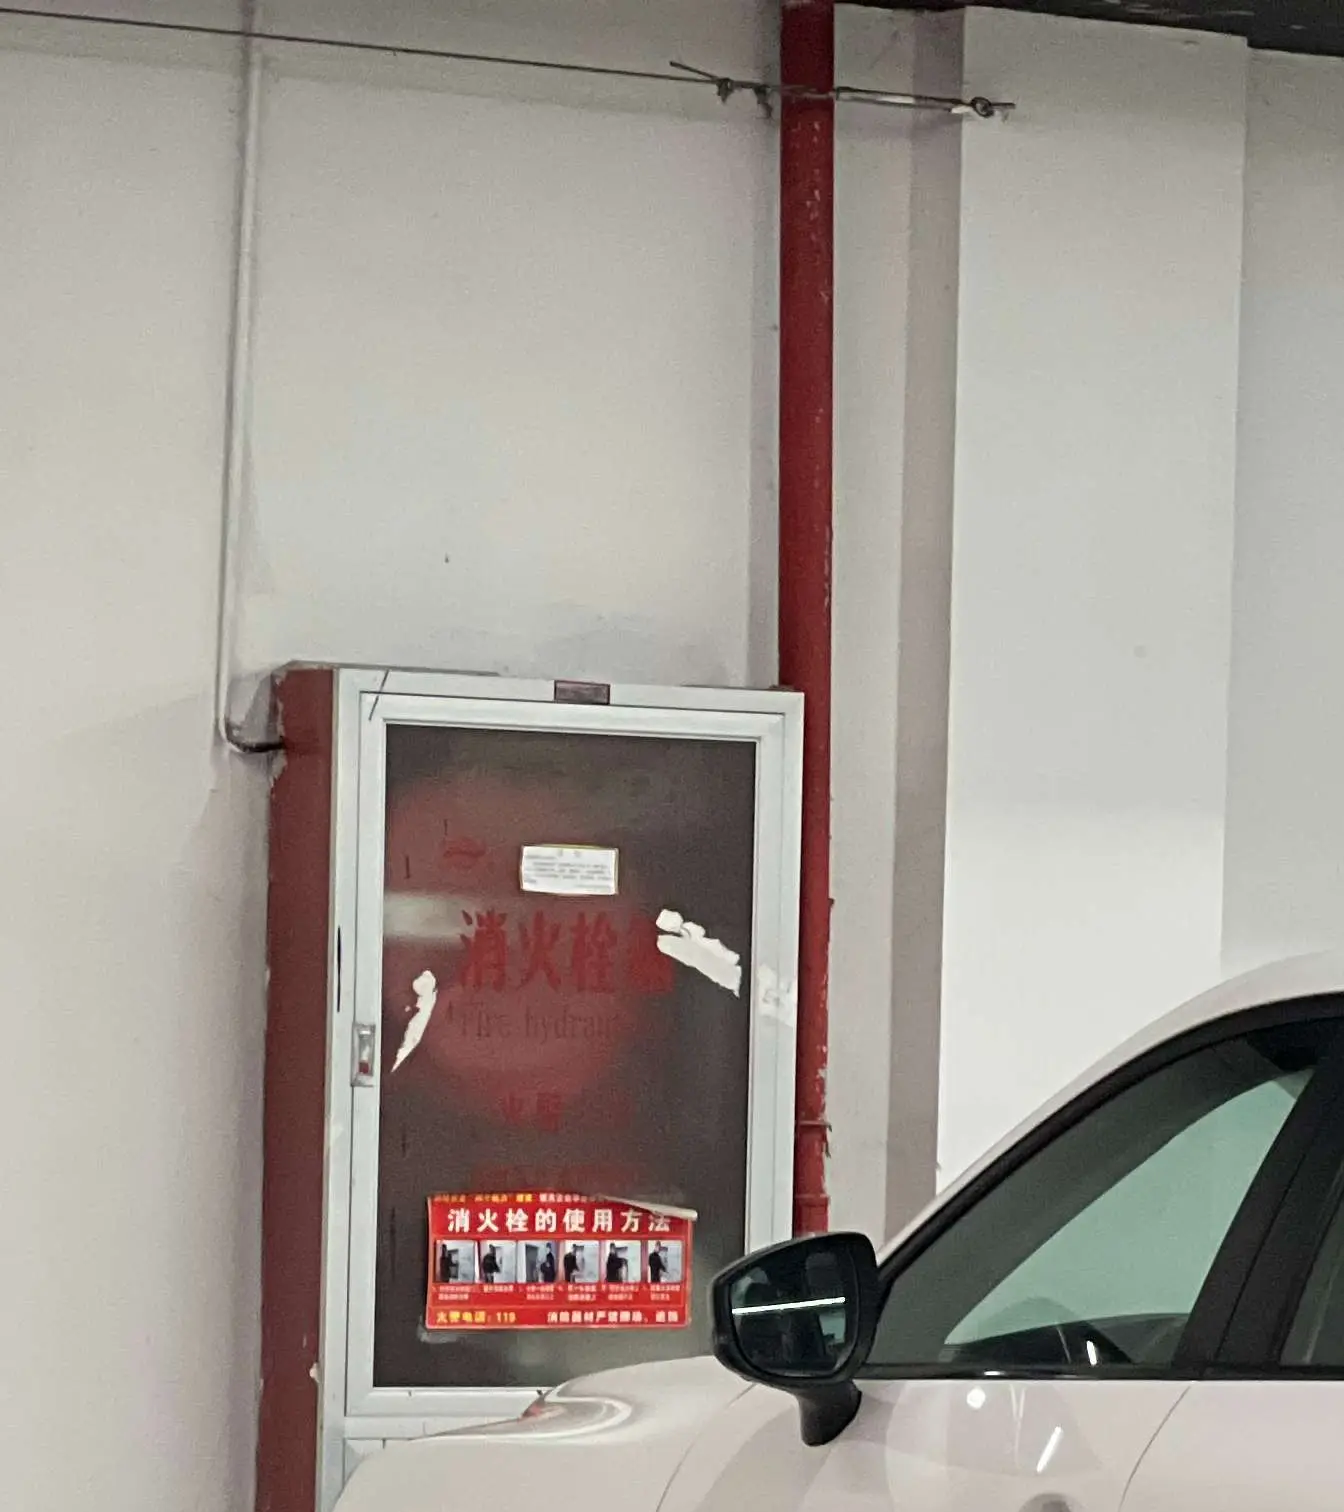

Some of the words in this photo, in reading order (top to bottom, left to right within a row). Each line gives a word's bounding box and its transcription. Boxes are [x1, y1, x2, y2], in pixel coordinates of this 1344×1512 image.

[447, 1206, 672, 1234] 消火栓的使用方法
